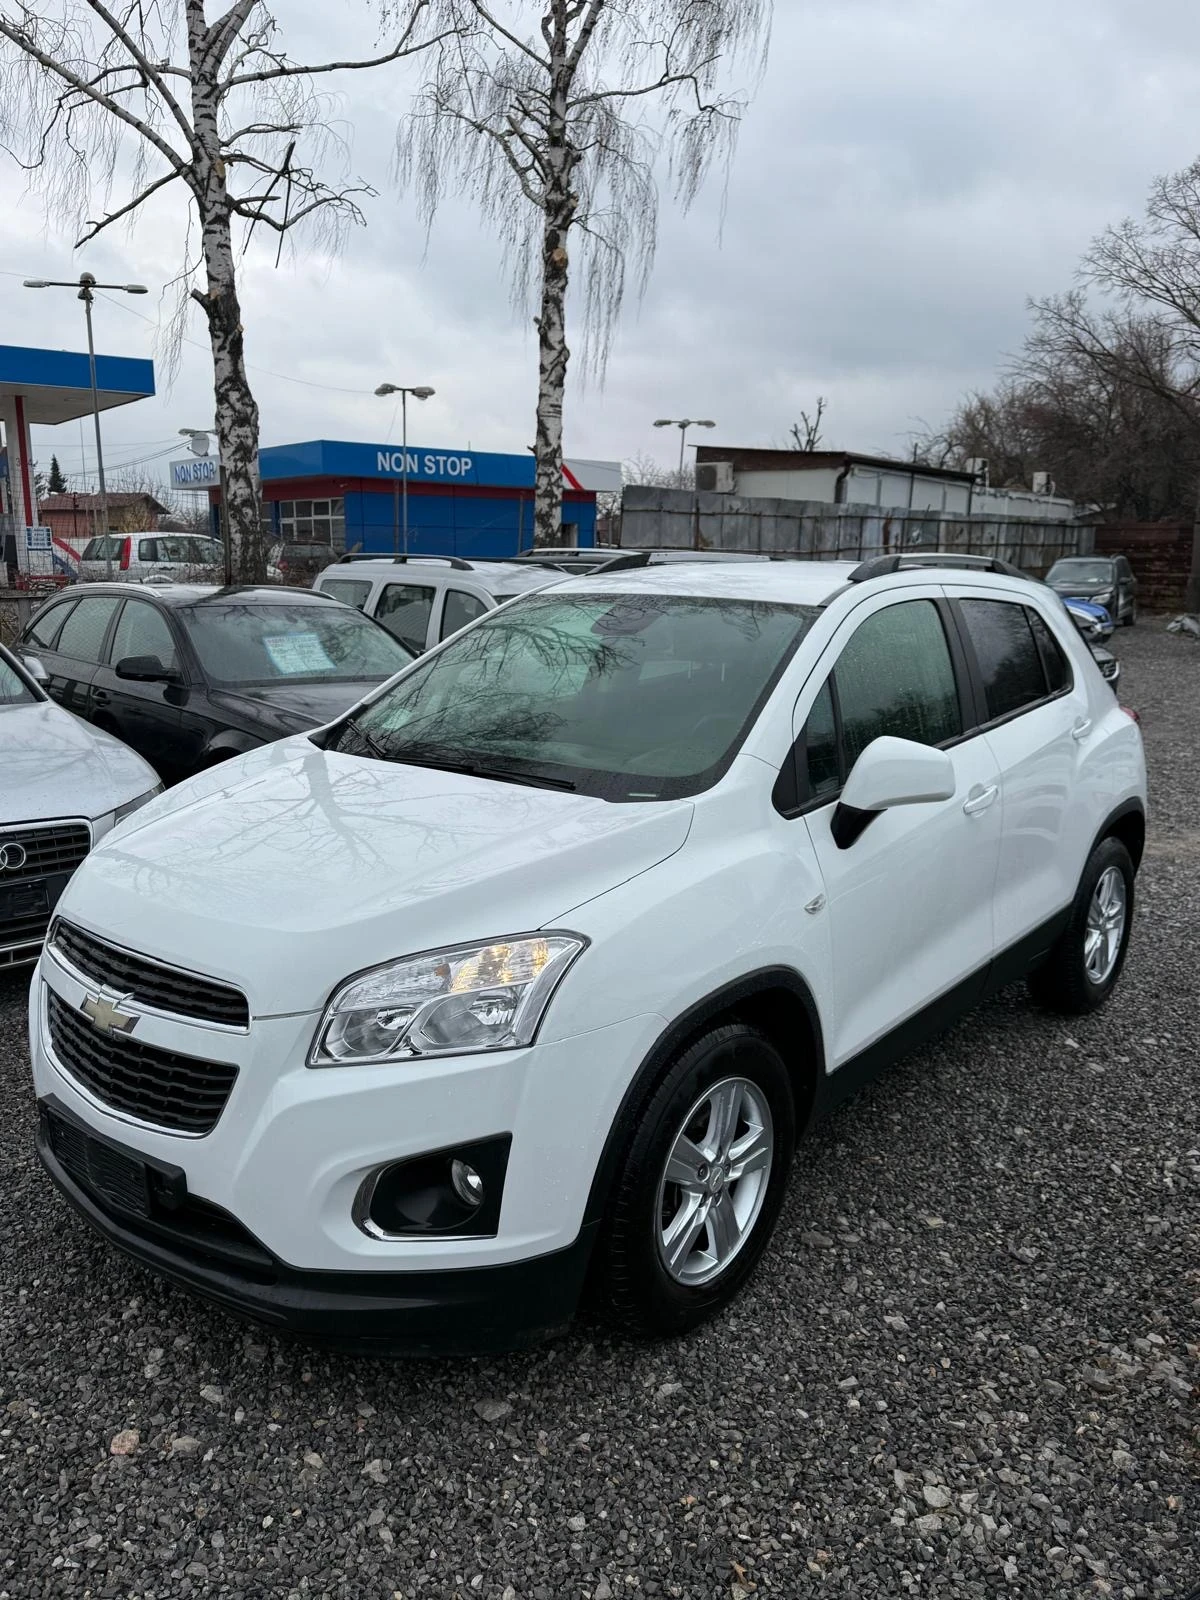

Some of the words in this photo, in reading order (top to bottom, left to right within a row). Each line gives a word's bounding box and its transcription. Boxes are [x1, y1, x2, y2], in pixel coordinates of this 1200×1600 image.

[175, 465, 191, 481] NON
[193, 462, 215, 480] STOP
[377, 452, 418, 473] NON
[424, 455, 472, 476] STOP
